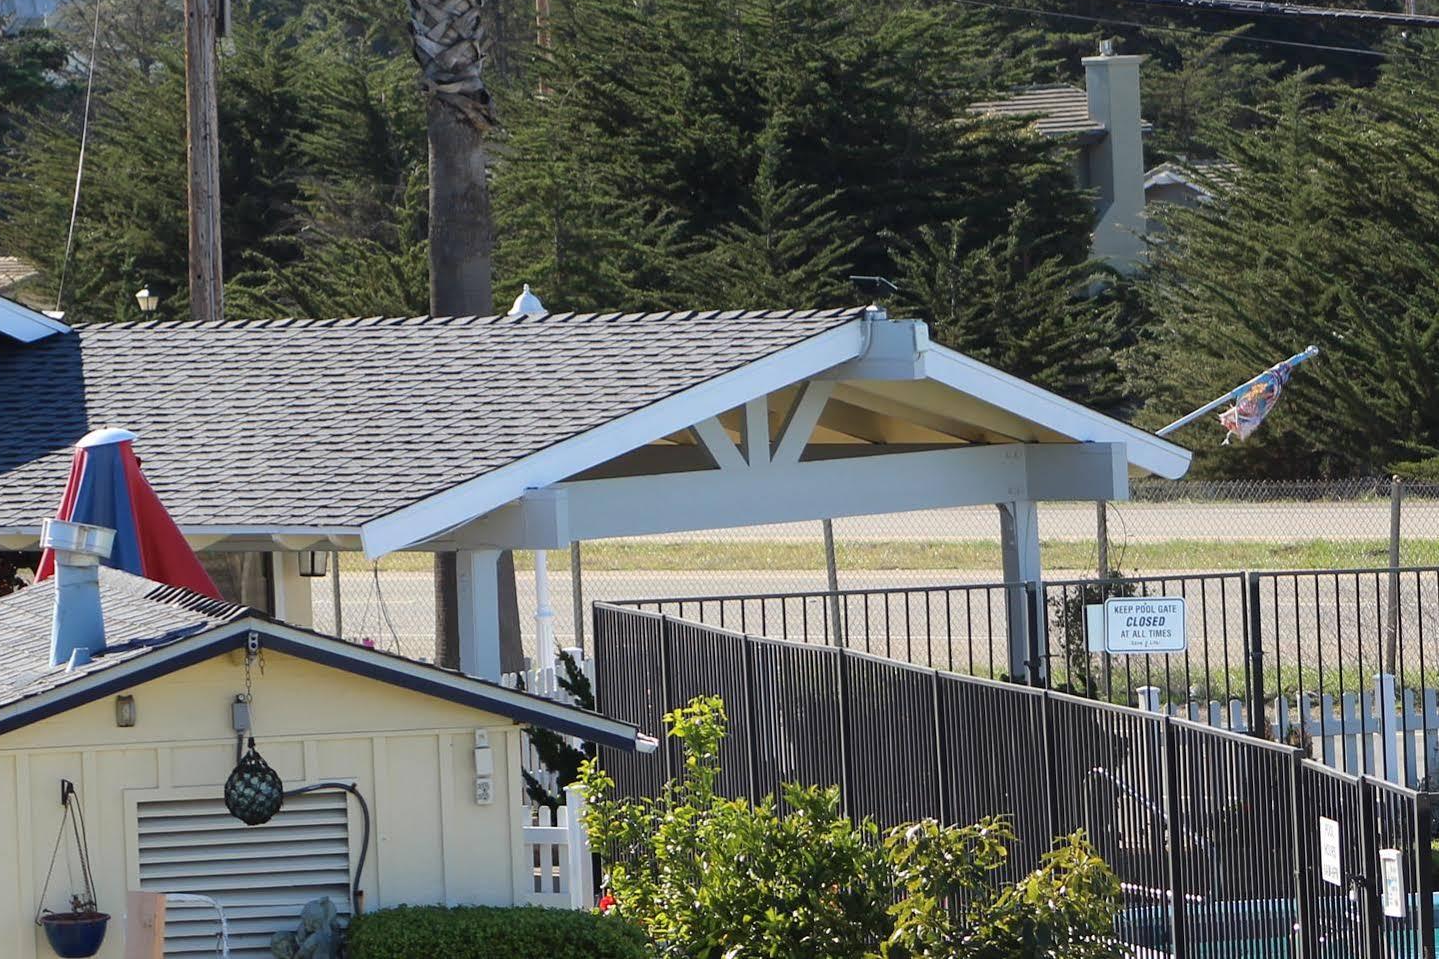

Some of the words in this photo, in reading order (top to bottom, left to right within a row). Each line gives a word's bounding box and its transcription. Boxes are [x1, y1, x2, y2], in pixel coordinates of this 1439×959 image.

[1114, 605, 1134, 614] KEEP
[1136, 605, 1155, 613] POOL
[1158, 604, 1177, 613] GATE
[1126, 616, 1165, 627] CLOSED
[1121, 630, 1129, 638] AT
[1132, 630, 1145, 638] ALL
[1149, 629, 1172, 638] TIMES
